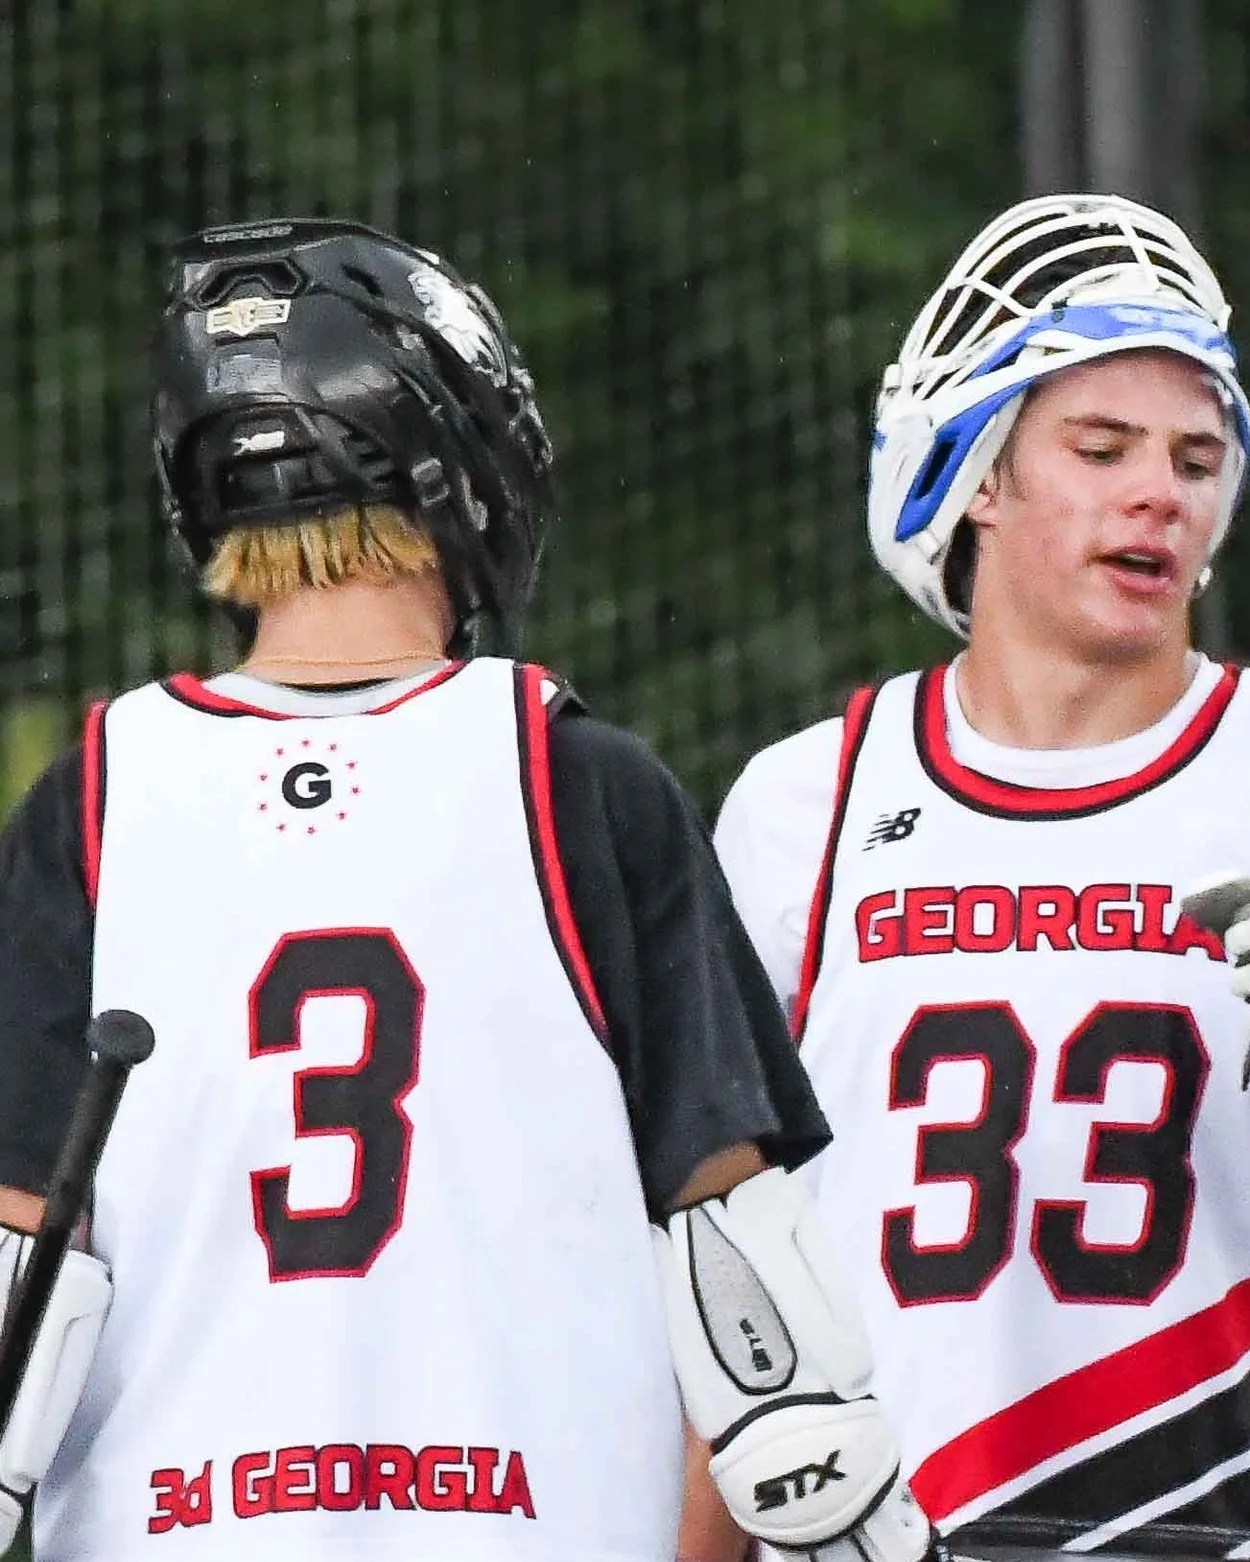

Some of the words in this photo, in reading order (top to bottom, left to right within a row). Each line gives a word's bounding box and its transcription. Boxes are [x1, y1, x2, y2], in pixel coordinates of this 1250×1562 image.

[281, 761, 332, 809] G
[247, 926, 427, 1283] 3
[881, 1000, 1212, 1308] 33
[147, 1459, 213, 1534] 3d
[231, 1443, 537, 1520] GEORGIA
[753, 1449, 848, 1513] STX
